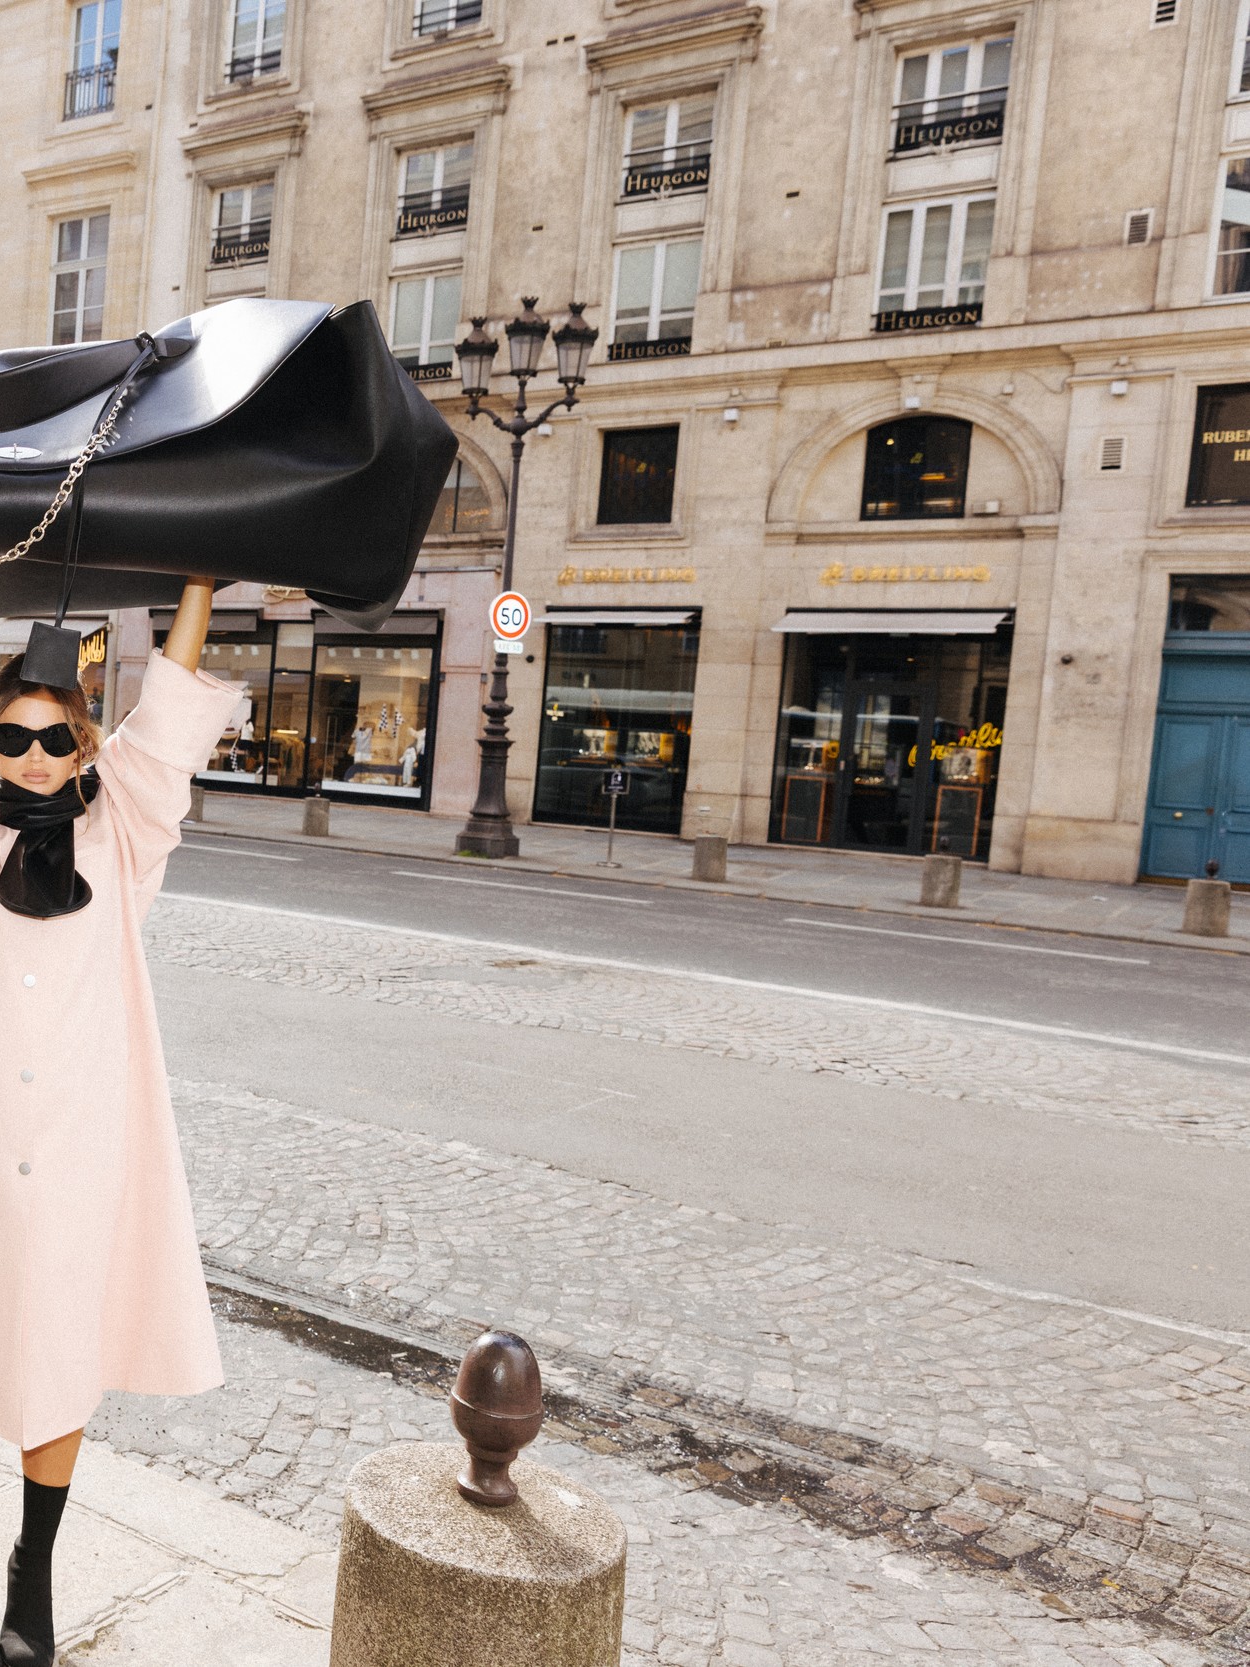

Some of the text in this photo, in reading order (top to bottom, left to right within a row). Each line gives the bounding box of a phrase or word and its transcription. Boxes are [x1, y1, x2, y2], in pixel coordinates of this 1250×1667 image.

[899, 117, 999, 146] HEURGON
[626, 168, 709, 193] HEURGON
[399, 208, 468, 230] HEURGON
[213, 240, 270, 259] HEURGON
[880, 310, 978, 331] HEURGON
[612, 341, 690, 360] HEURGON
[500, 607, 523, 627] 50
